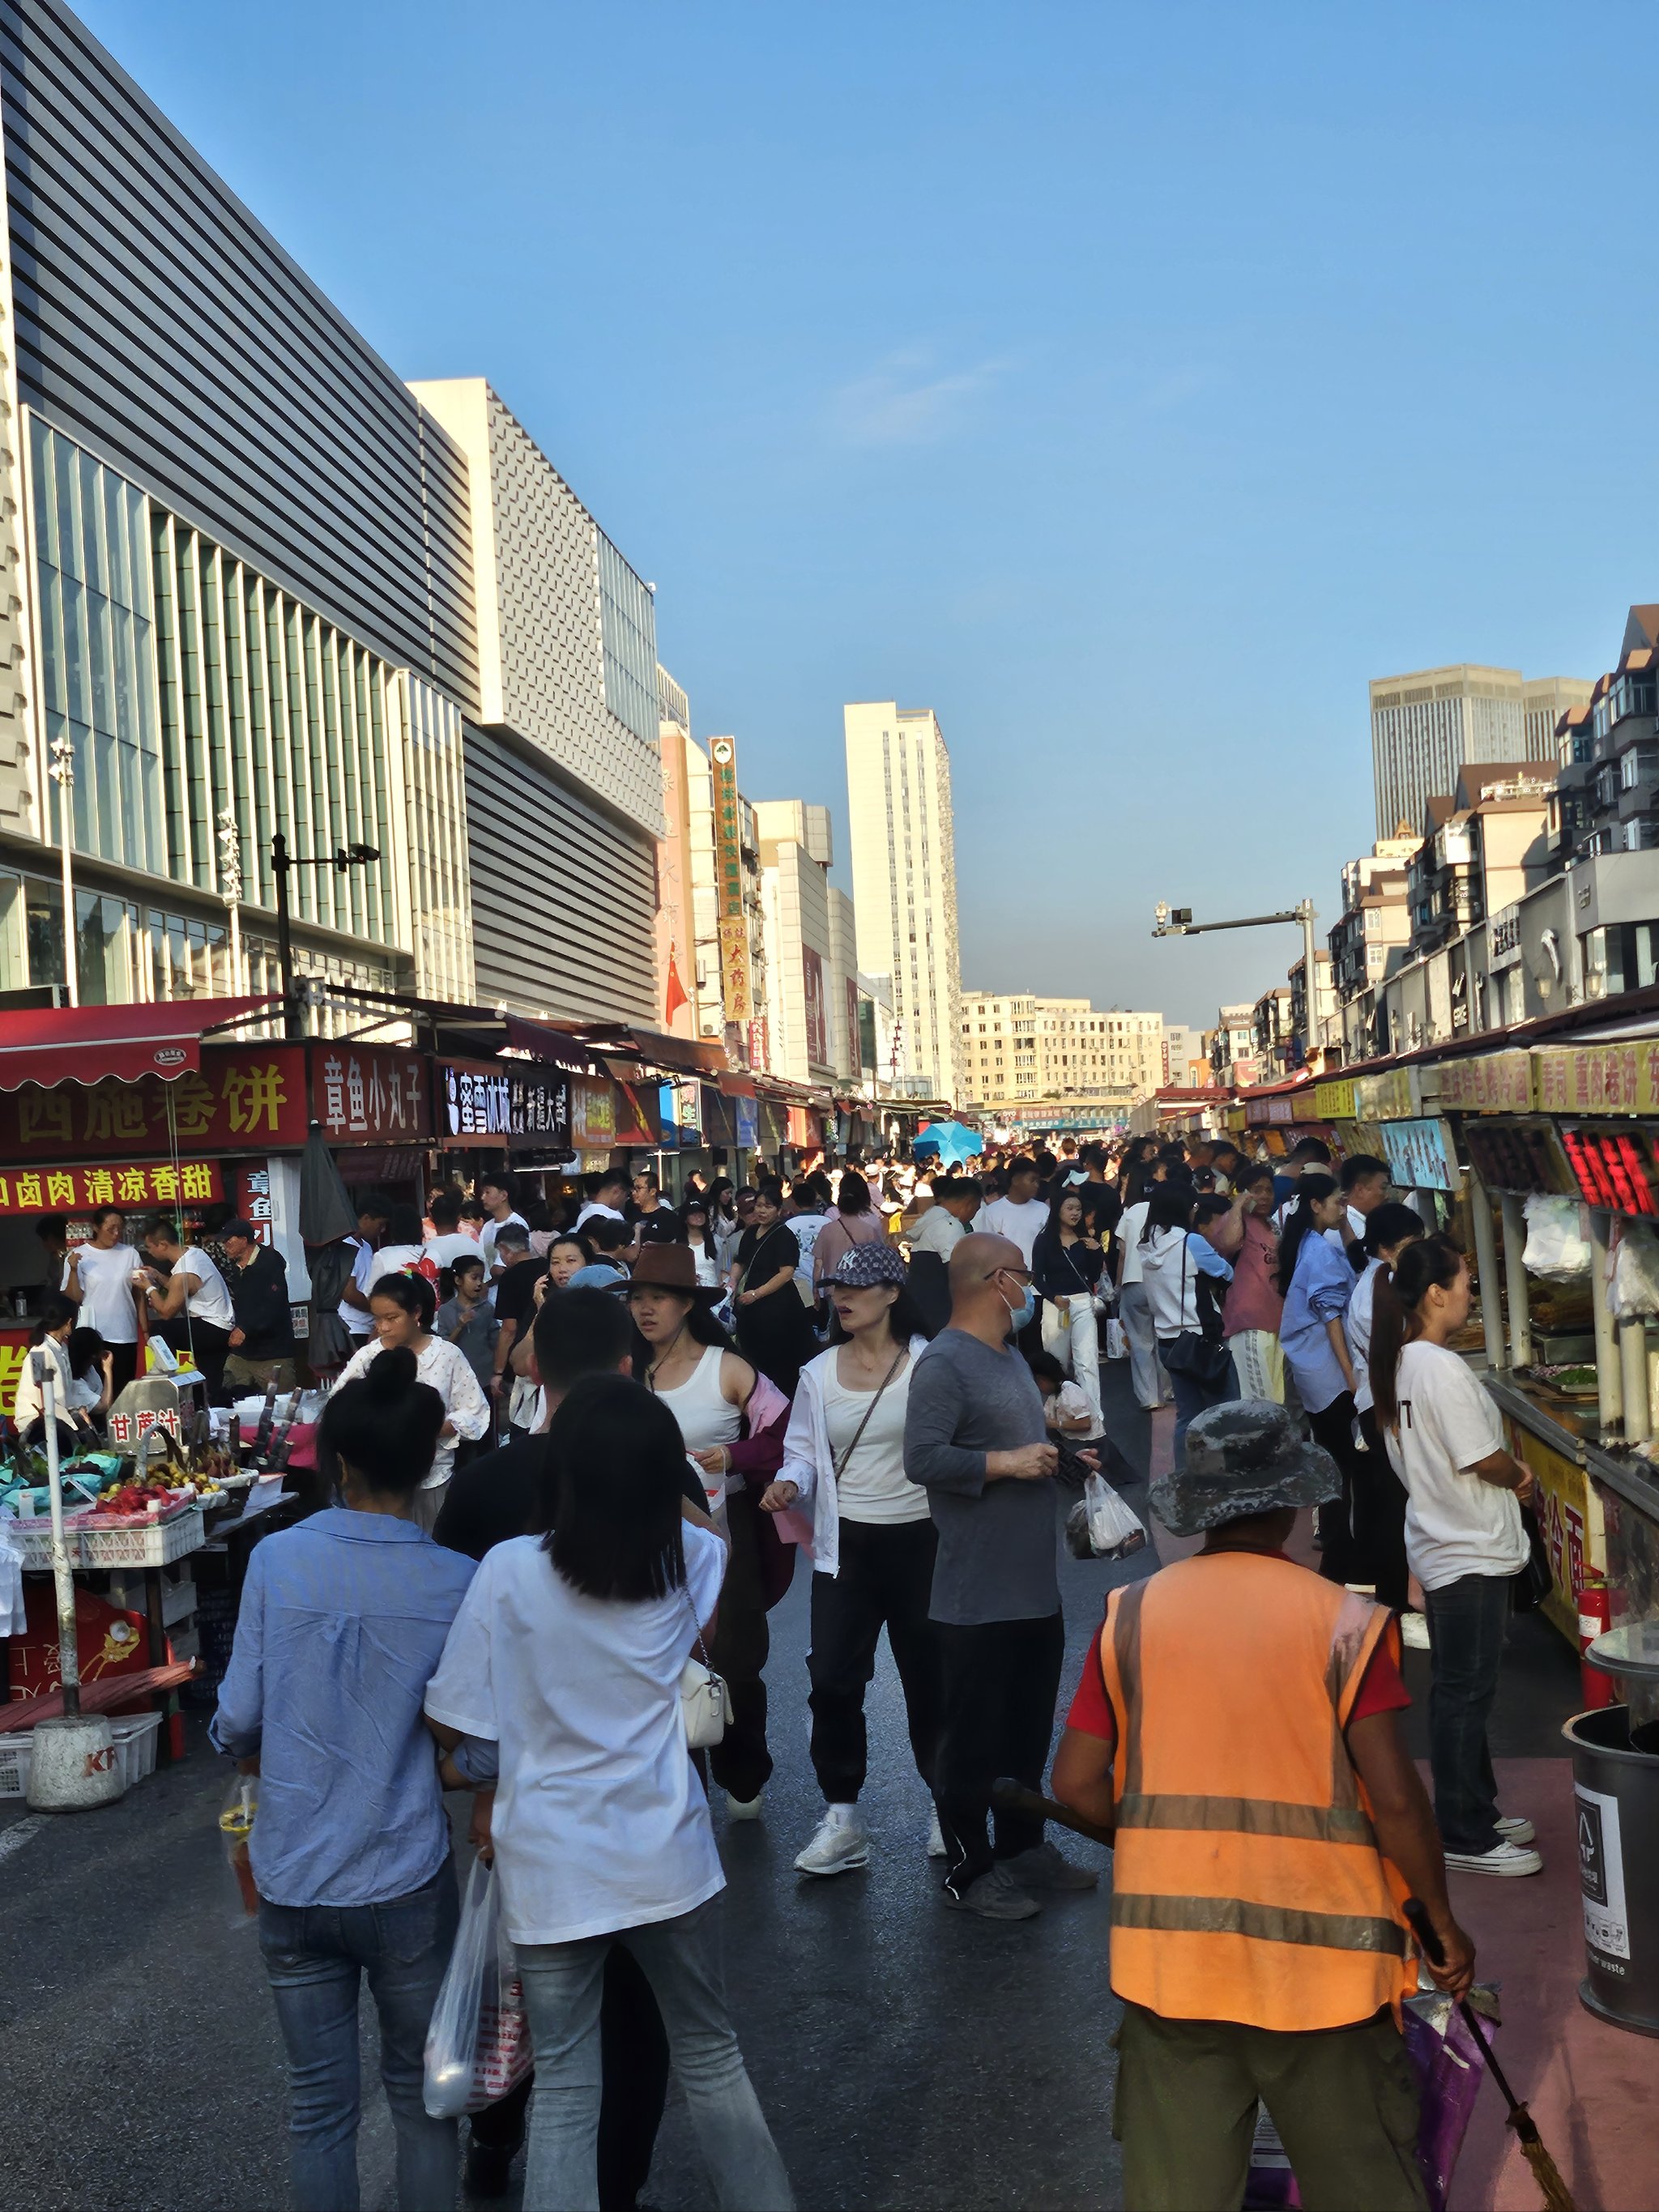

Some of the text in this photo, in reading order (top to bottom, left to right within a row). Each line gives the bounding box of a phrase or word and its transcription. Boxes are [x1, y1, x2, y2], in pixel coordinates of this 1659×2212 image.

[18, 1063, 288, 1143] 西施卷饼
[324, 1055, 422, 1135] 章鱼小丸子
[459, 1072, 512, 1133] 蜜雪冰城
[83, 1163, 212, 1204] 清凉香甜
[247, 1170, 273, 1247] 章鱼小
[109, 1409, 181, 1443] 甘蔗汁
